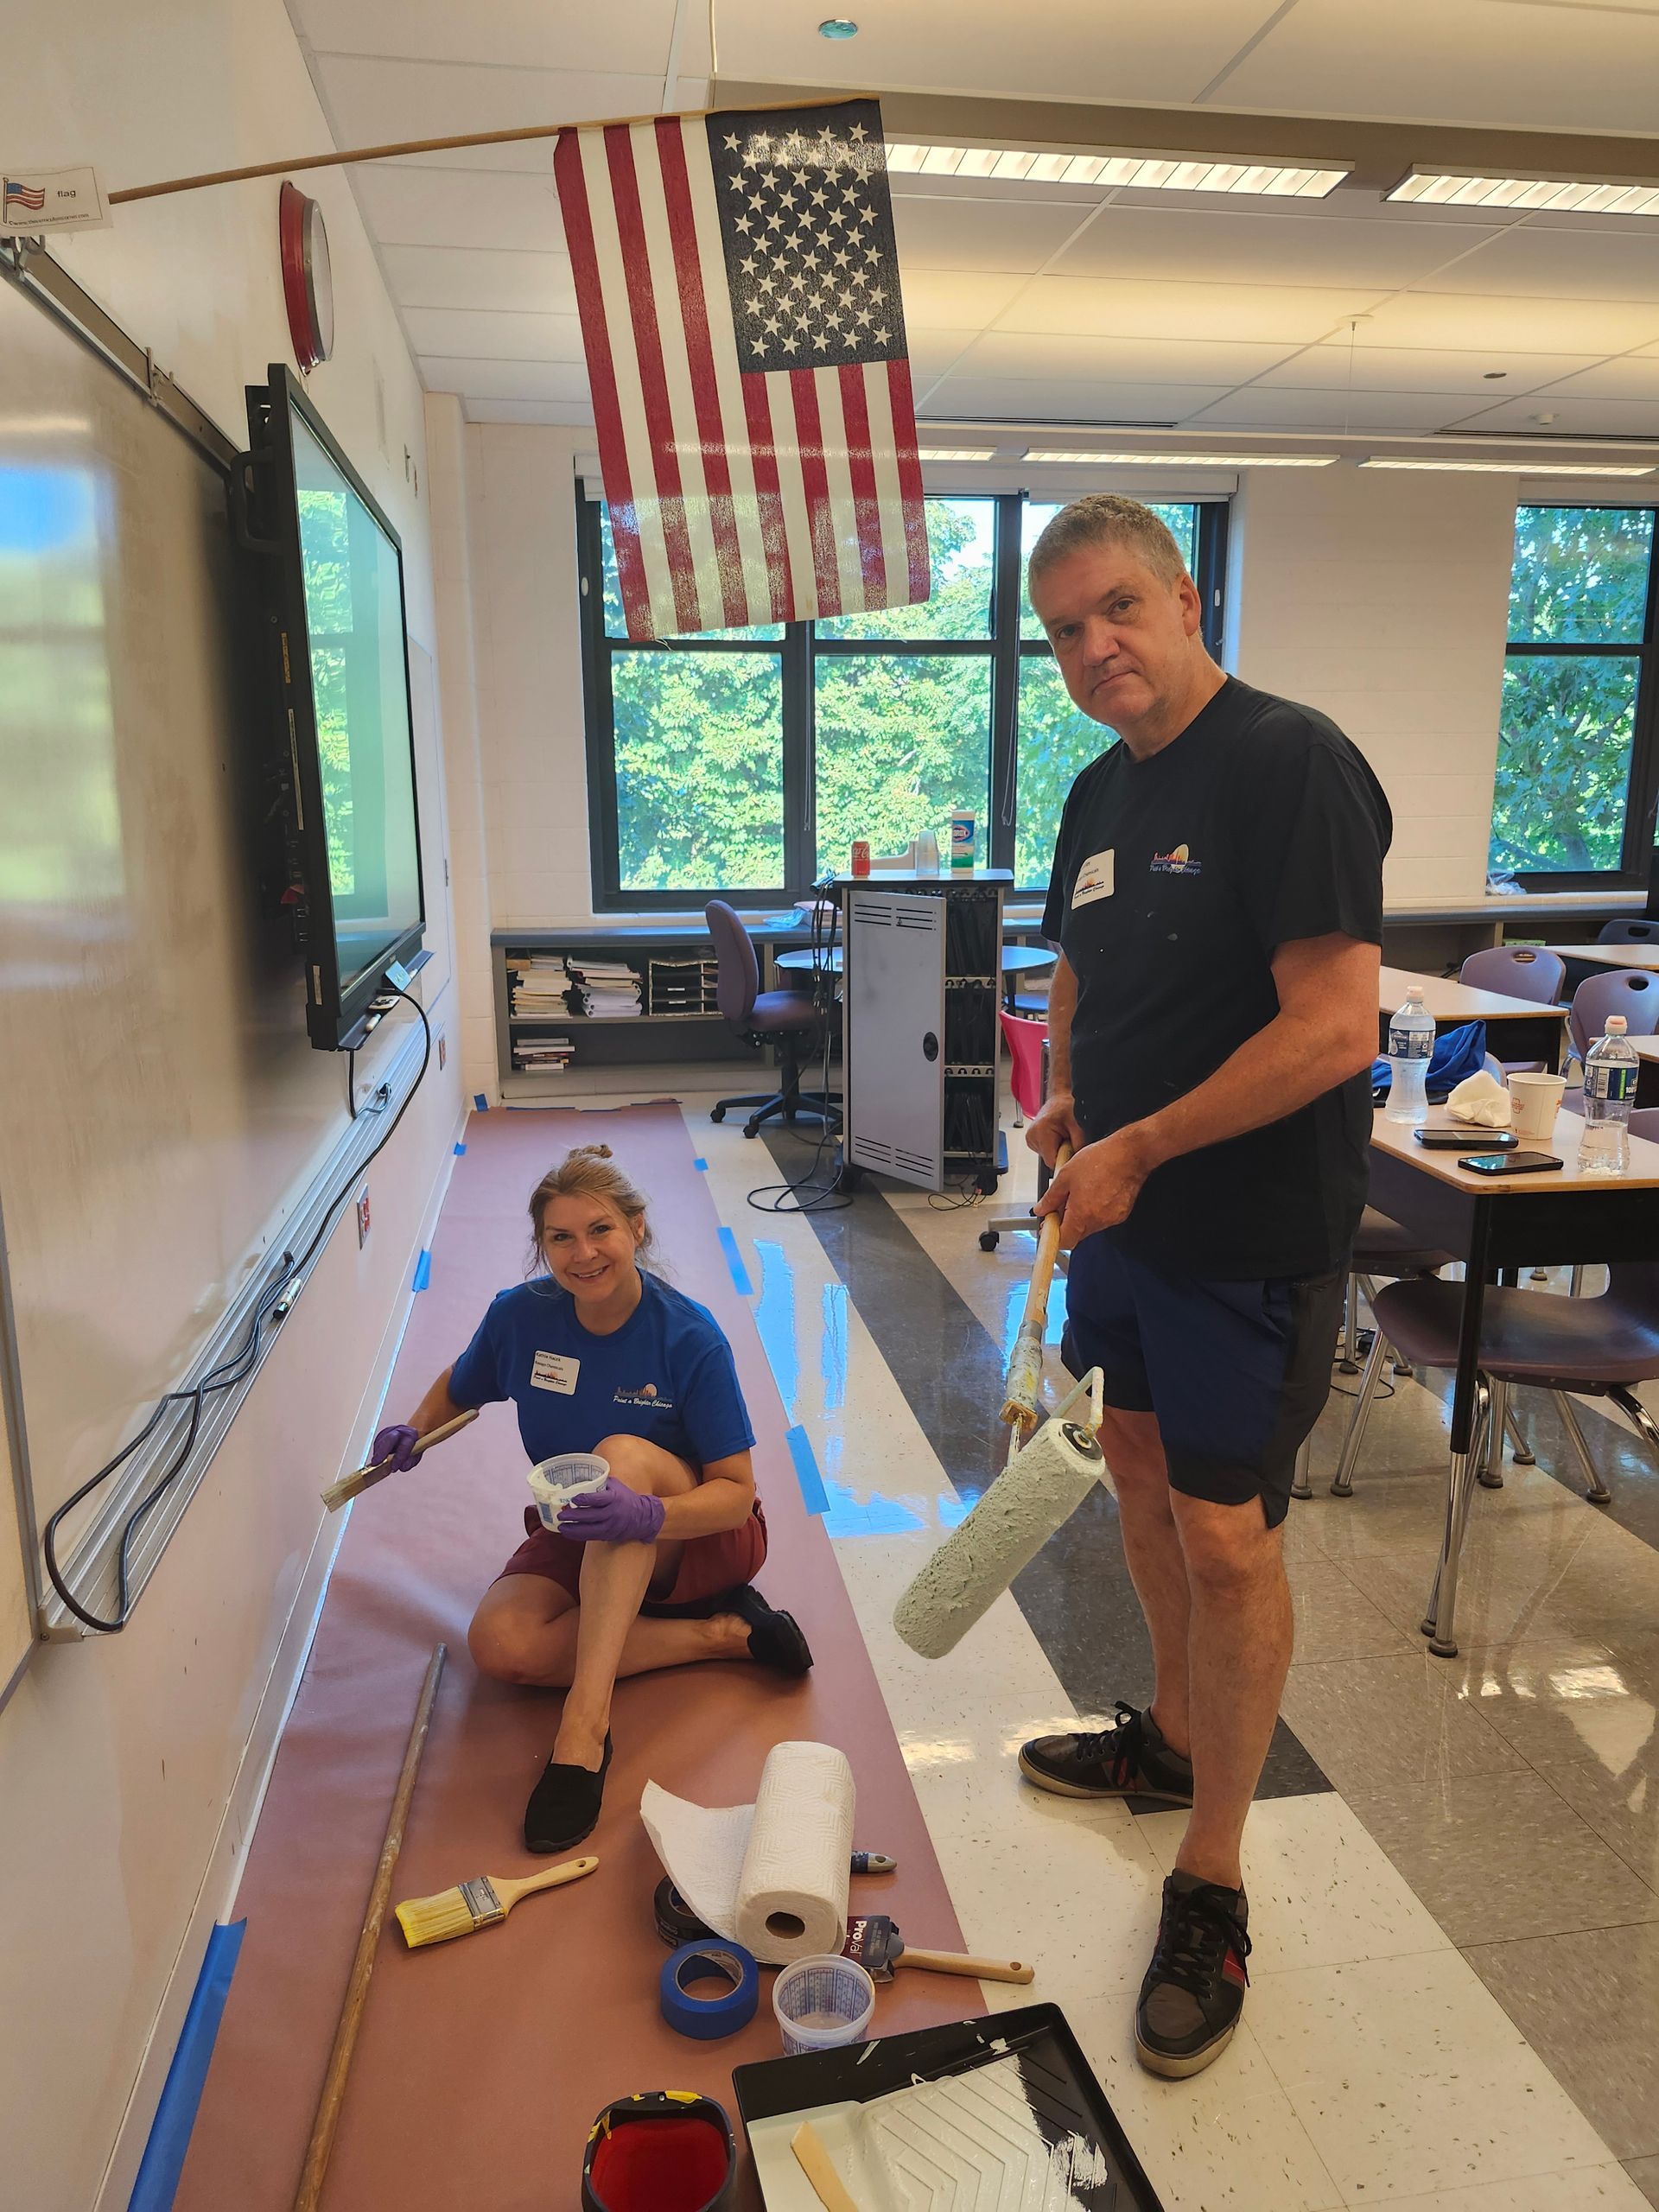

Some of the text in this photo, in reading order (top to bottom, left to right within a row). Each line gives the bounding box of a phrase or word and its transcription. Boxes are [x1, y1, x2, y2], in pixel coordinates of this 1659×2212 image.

[57, 190, 77, 199] flag
[613, 1395, 627, 1404] Paint
[652, 1399, 673, 1410] Chicago
[849, 1920, 868, 1955] ProVal
